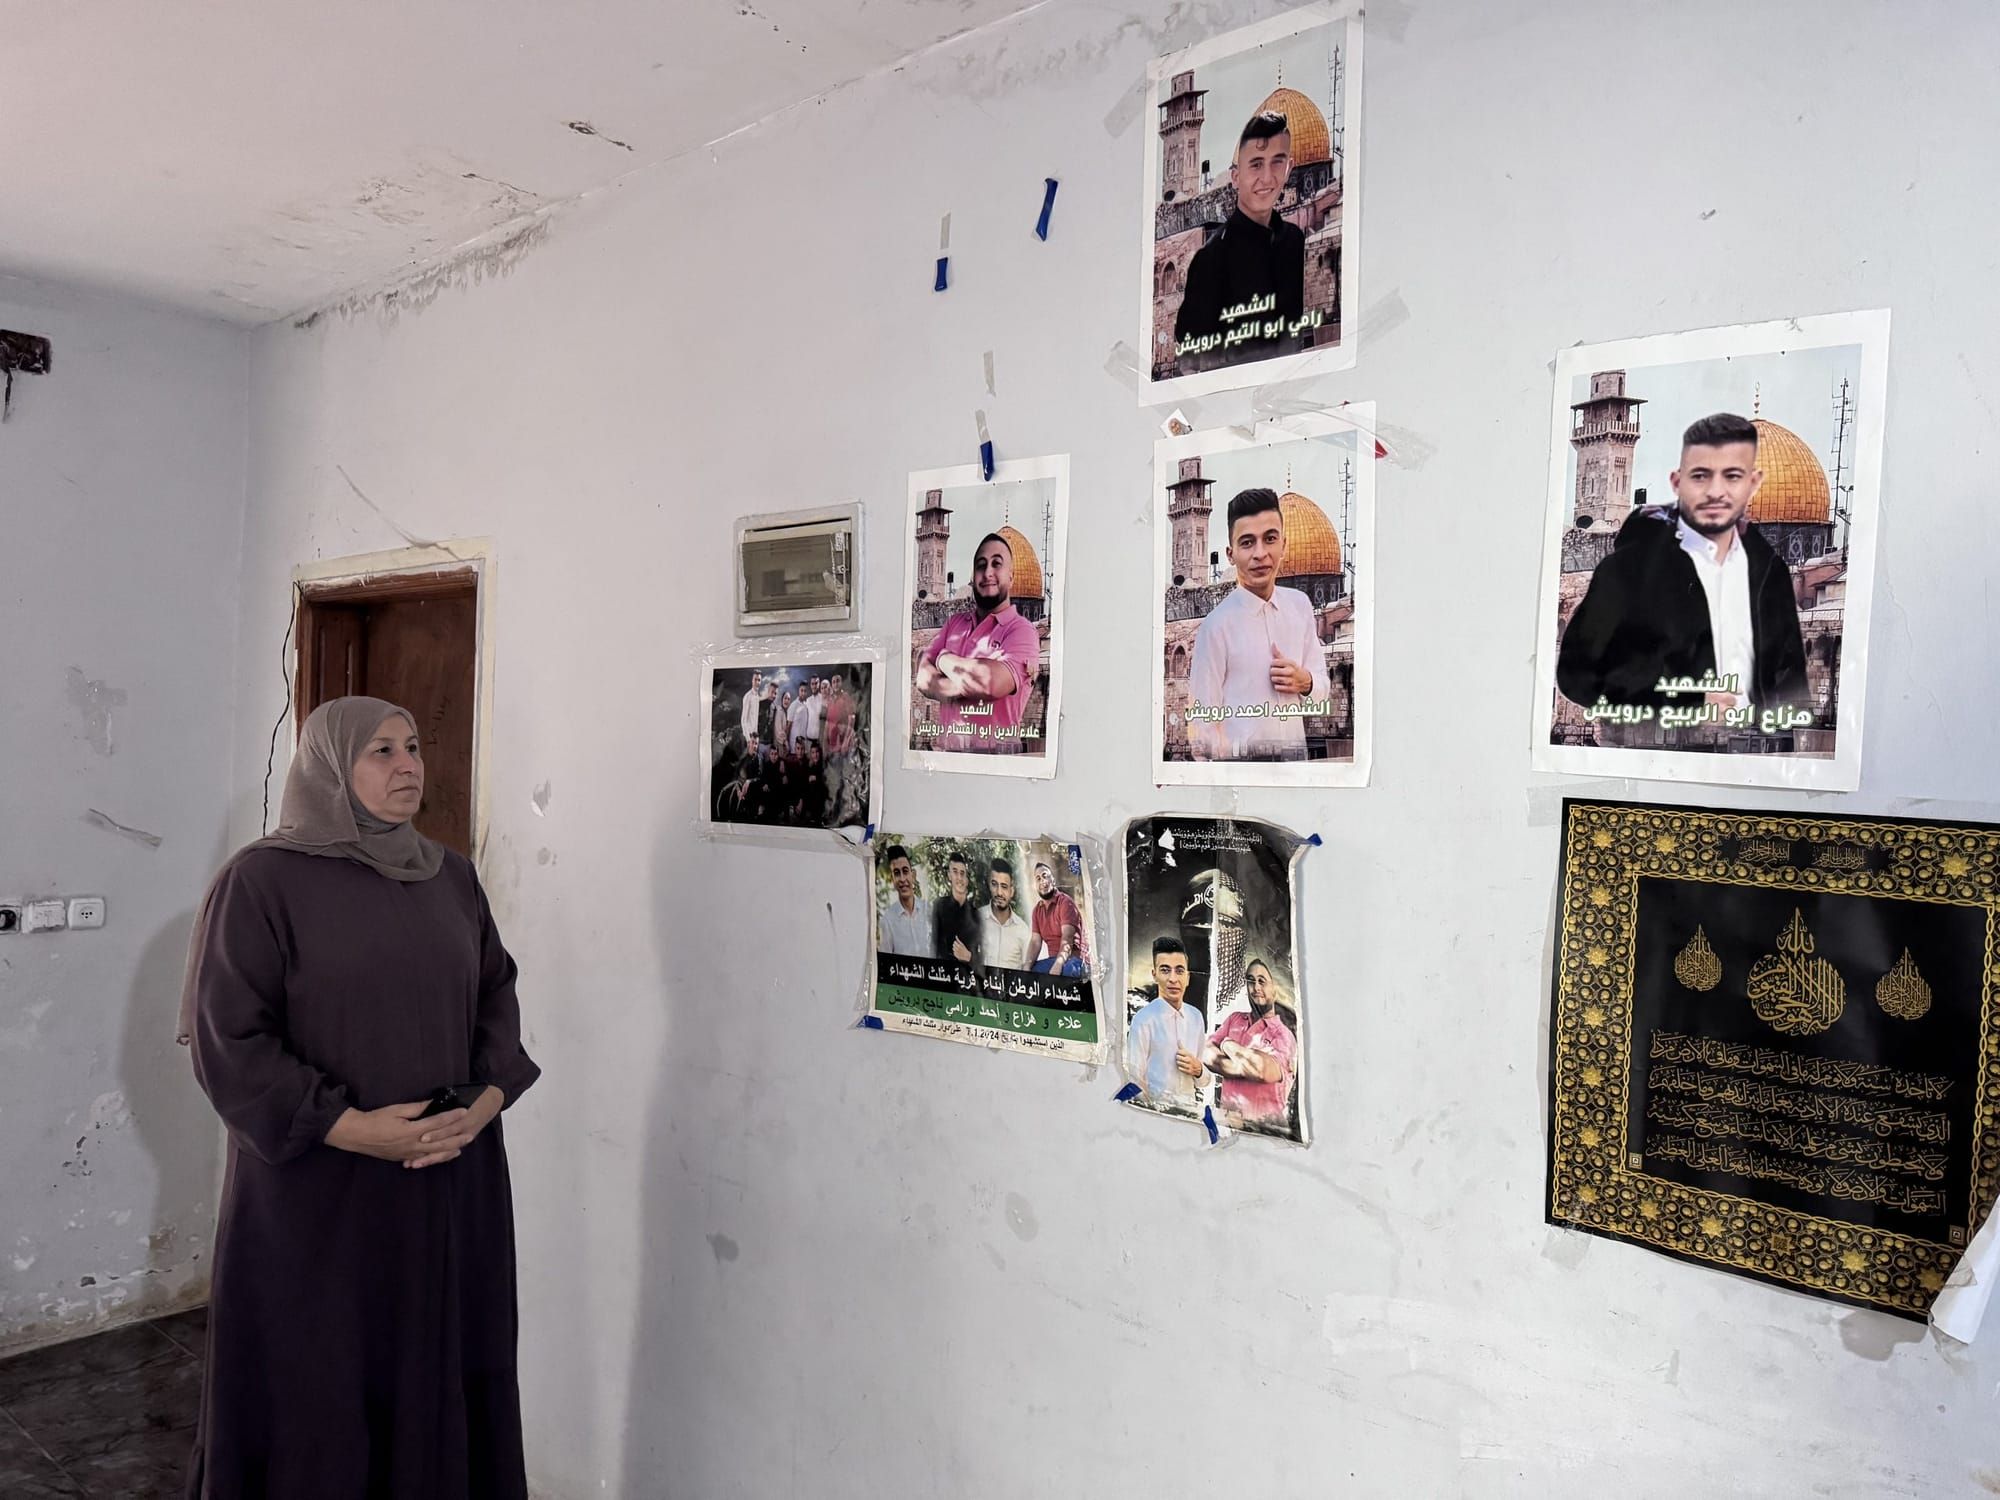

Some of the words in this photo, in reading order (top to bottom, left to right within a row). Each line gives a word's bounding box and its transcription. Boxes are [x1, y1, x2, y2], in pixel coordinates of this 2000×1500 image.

[1219, 292, 1276, 322] الشهيد
[1264, 316, 1284, 339] ابو
[1288, 310, 1322, 336] رامي
[1175, 332, 1222, 356] درويش
[1225, 321, 1260, 348] التيم
[1654, 668, 1739, 697] الشهيد
[959, 700, 994, 718] الشهيد
[1184, 699, 1232, 721] درويش
[1236, 702, 1270, 718] احمد
[1272, 696, 1331, 721] الشهيد
[1583, 695, 1654, 725] درويش
[1660, 703, 1718, 728] الربيع
[1725, 705, 1755, 728] ابو
[1761, 705, 1814, 733] هزاع
[915, 721, 945, 738] درويش
[946, 722, 977, 738] القسام
[979, 724, 992, 739] ابو
[994, 725, 1017, 740] الدين
[1019, 726, 1040, 739] علاء
[889, 962, 925, 982] الشهداء
[928, 966, 951, 982] مثلث
[954, 967, 976, 989] قرية
[983, 973, 1005, 995] أبناء
[1008, 977, 1040, 1000] الوطن
[1044, 984, 1081, 1006] شهداء
[888, 990, 920, 1008] درويش
[979, 1003, 1000, 1019] أحمد
[1012, 1009, 1036, 1028] هزاع
[1058, 1015, 1082, 1029] علاء
